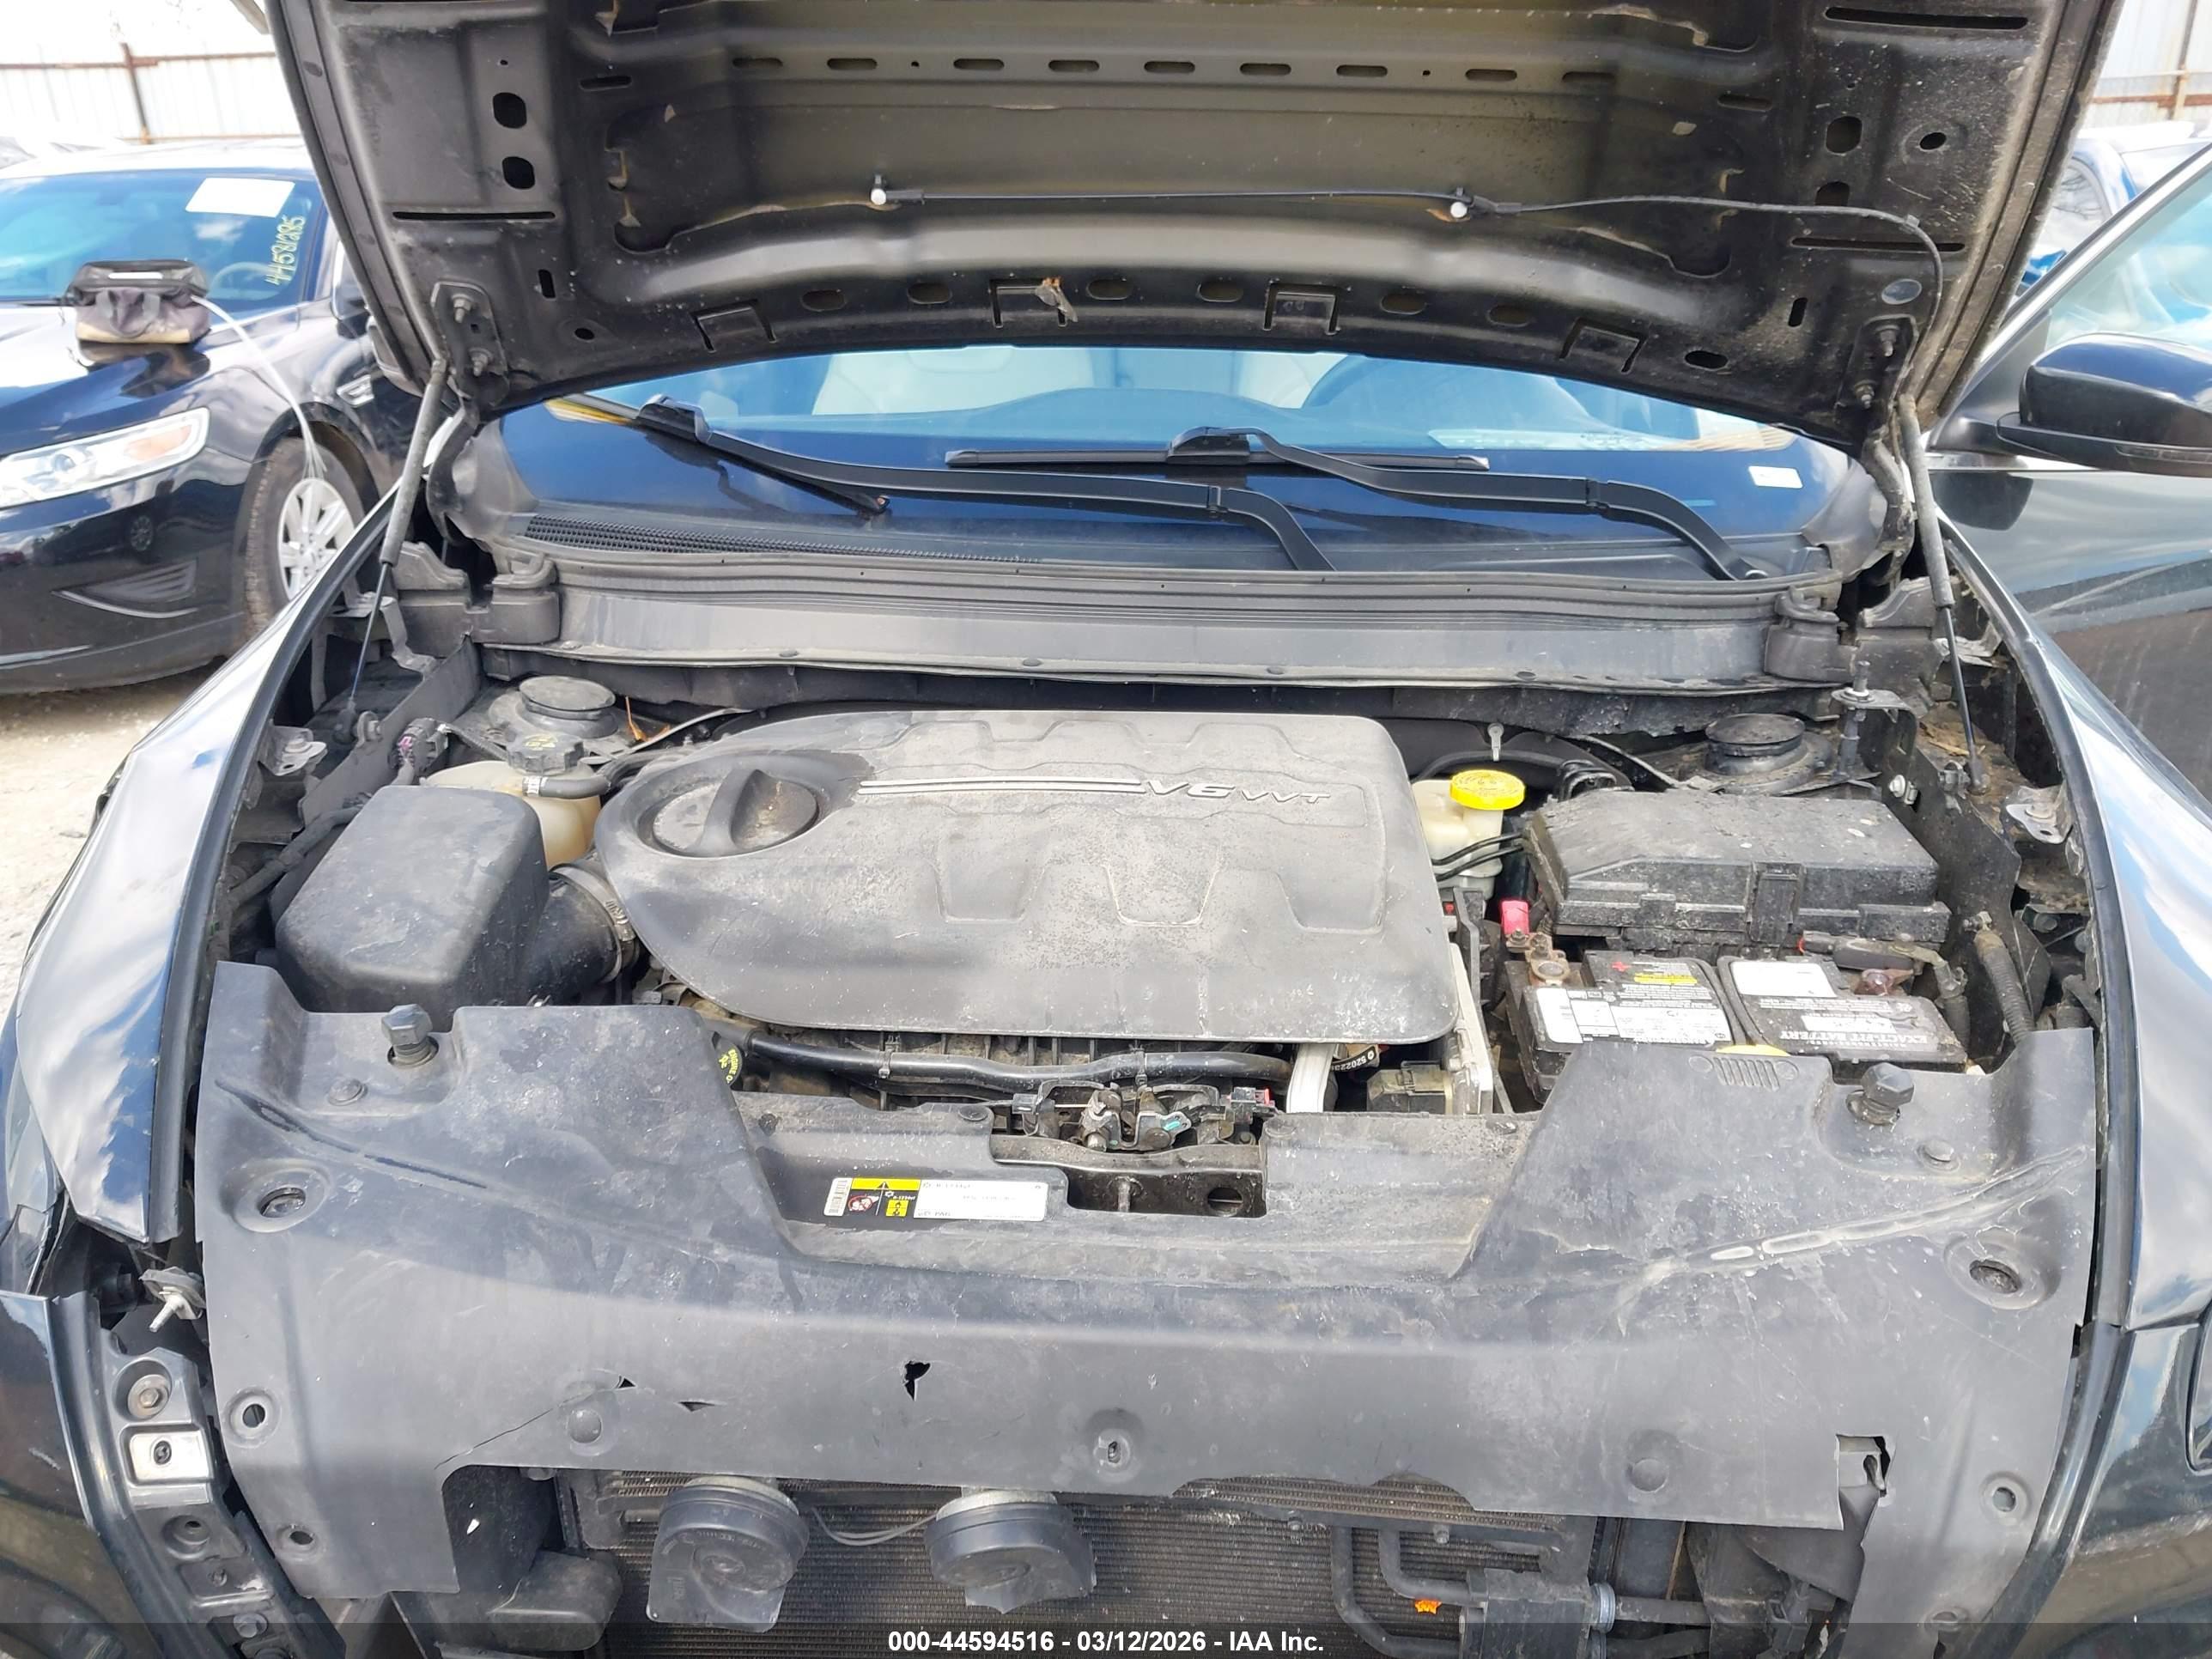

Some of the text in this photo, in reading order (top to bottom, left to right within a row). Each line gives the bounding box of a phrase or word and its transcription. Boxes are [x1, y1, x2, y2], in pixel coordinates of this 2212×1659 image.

[1147, 780, 1331, 804] V6 VVT
[1780, 1030, 1846, 1042] BATTERY
